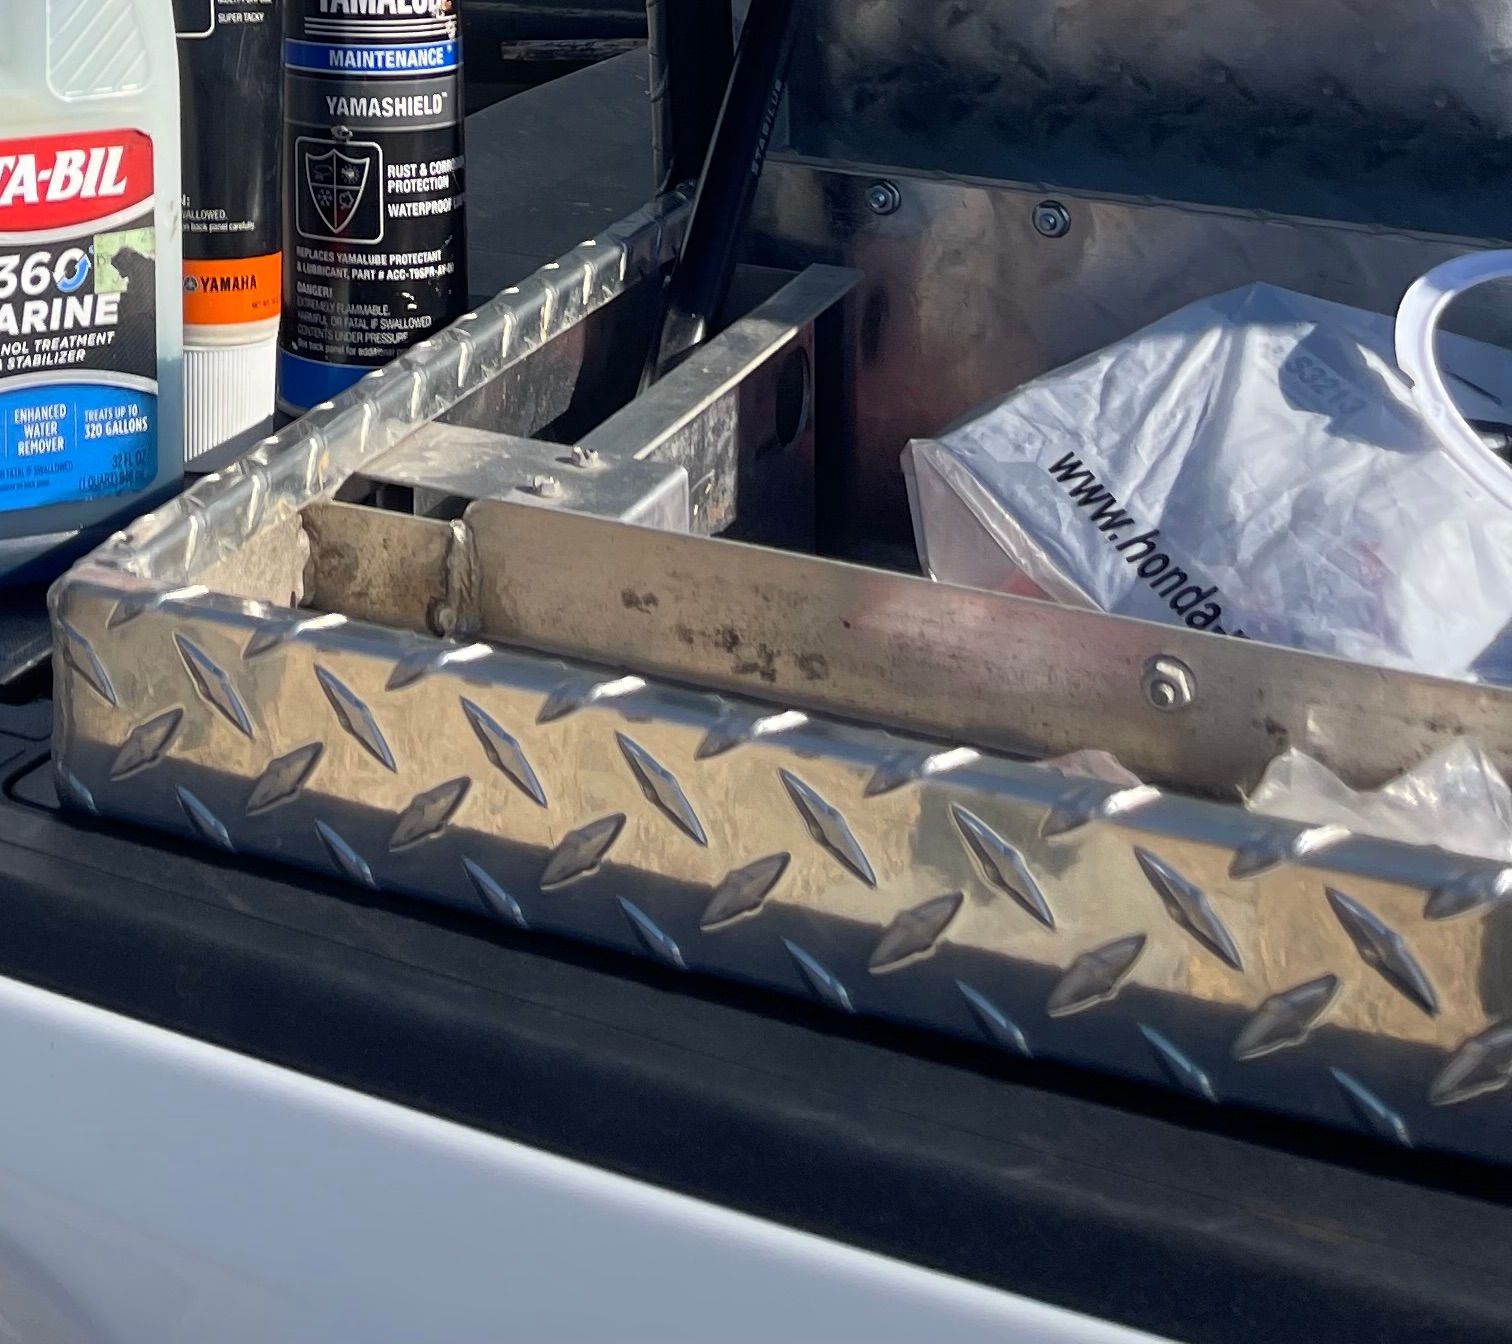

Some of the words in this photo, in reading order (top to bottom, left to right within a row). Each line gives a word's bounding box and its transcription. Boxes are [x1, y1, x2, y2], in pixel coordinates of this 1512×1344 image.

[329, 47, 444, 69] MAINTENANCE
[326, 94, 443, 118] YAMASHIELD
[388, 163, 417, 179] RUST
[420, 162, 428, 177] &
[388, 175, 449, 193] PROTECTION
[388, 198, 452, 218] WATERPROOF
[389, 249, 442, 265] PROTECTANT
[352, 268, 375, 280] PART
[200, 275, 257, 293] YAMAHA
[380, 316, 432, 330] SWALLOWED
[34, 330, 116, 353] TREATMENT
[7, 347, 86, 371] STABILIZER
[14, 403, 67, 424] ENHANCED
[85, 407, 113, 422] TREATS
[115, 405, 126, 419] UP
[128, 403, 138, 417] TO
[24, 421, 58, 439] WATER
[105, 415, 148, 436] GALLONS
[17, 436, 64, 456] REMOVER
